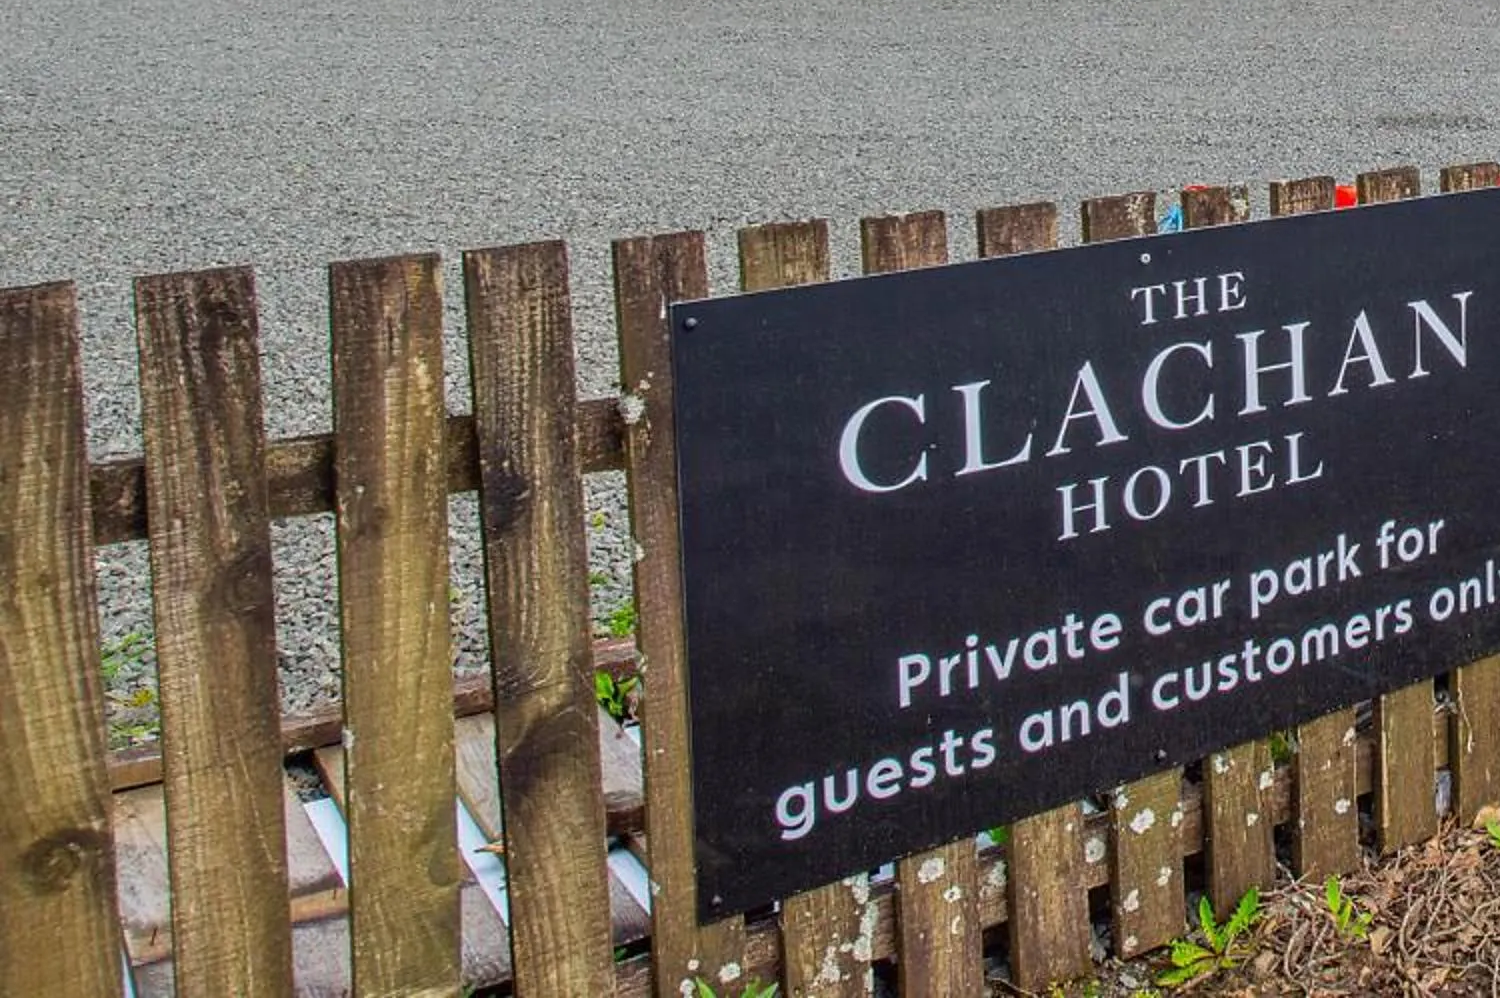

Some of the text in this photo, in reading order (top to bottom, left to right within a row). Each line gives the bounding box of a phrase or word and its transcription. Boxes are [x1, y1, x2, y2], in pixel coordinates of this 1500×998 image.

[839, 290, 1475, 493] CLACHAN
[1131, 271, 1247, 325] THE
[1055, 432, 1324, 542] HOTEL
[898, 519, 1446, 708] Private car park for
[775, 728, 996, 840] guests
[1019, 671, 1130, 752] and
[1151, 599, 1413, 711] customers
